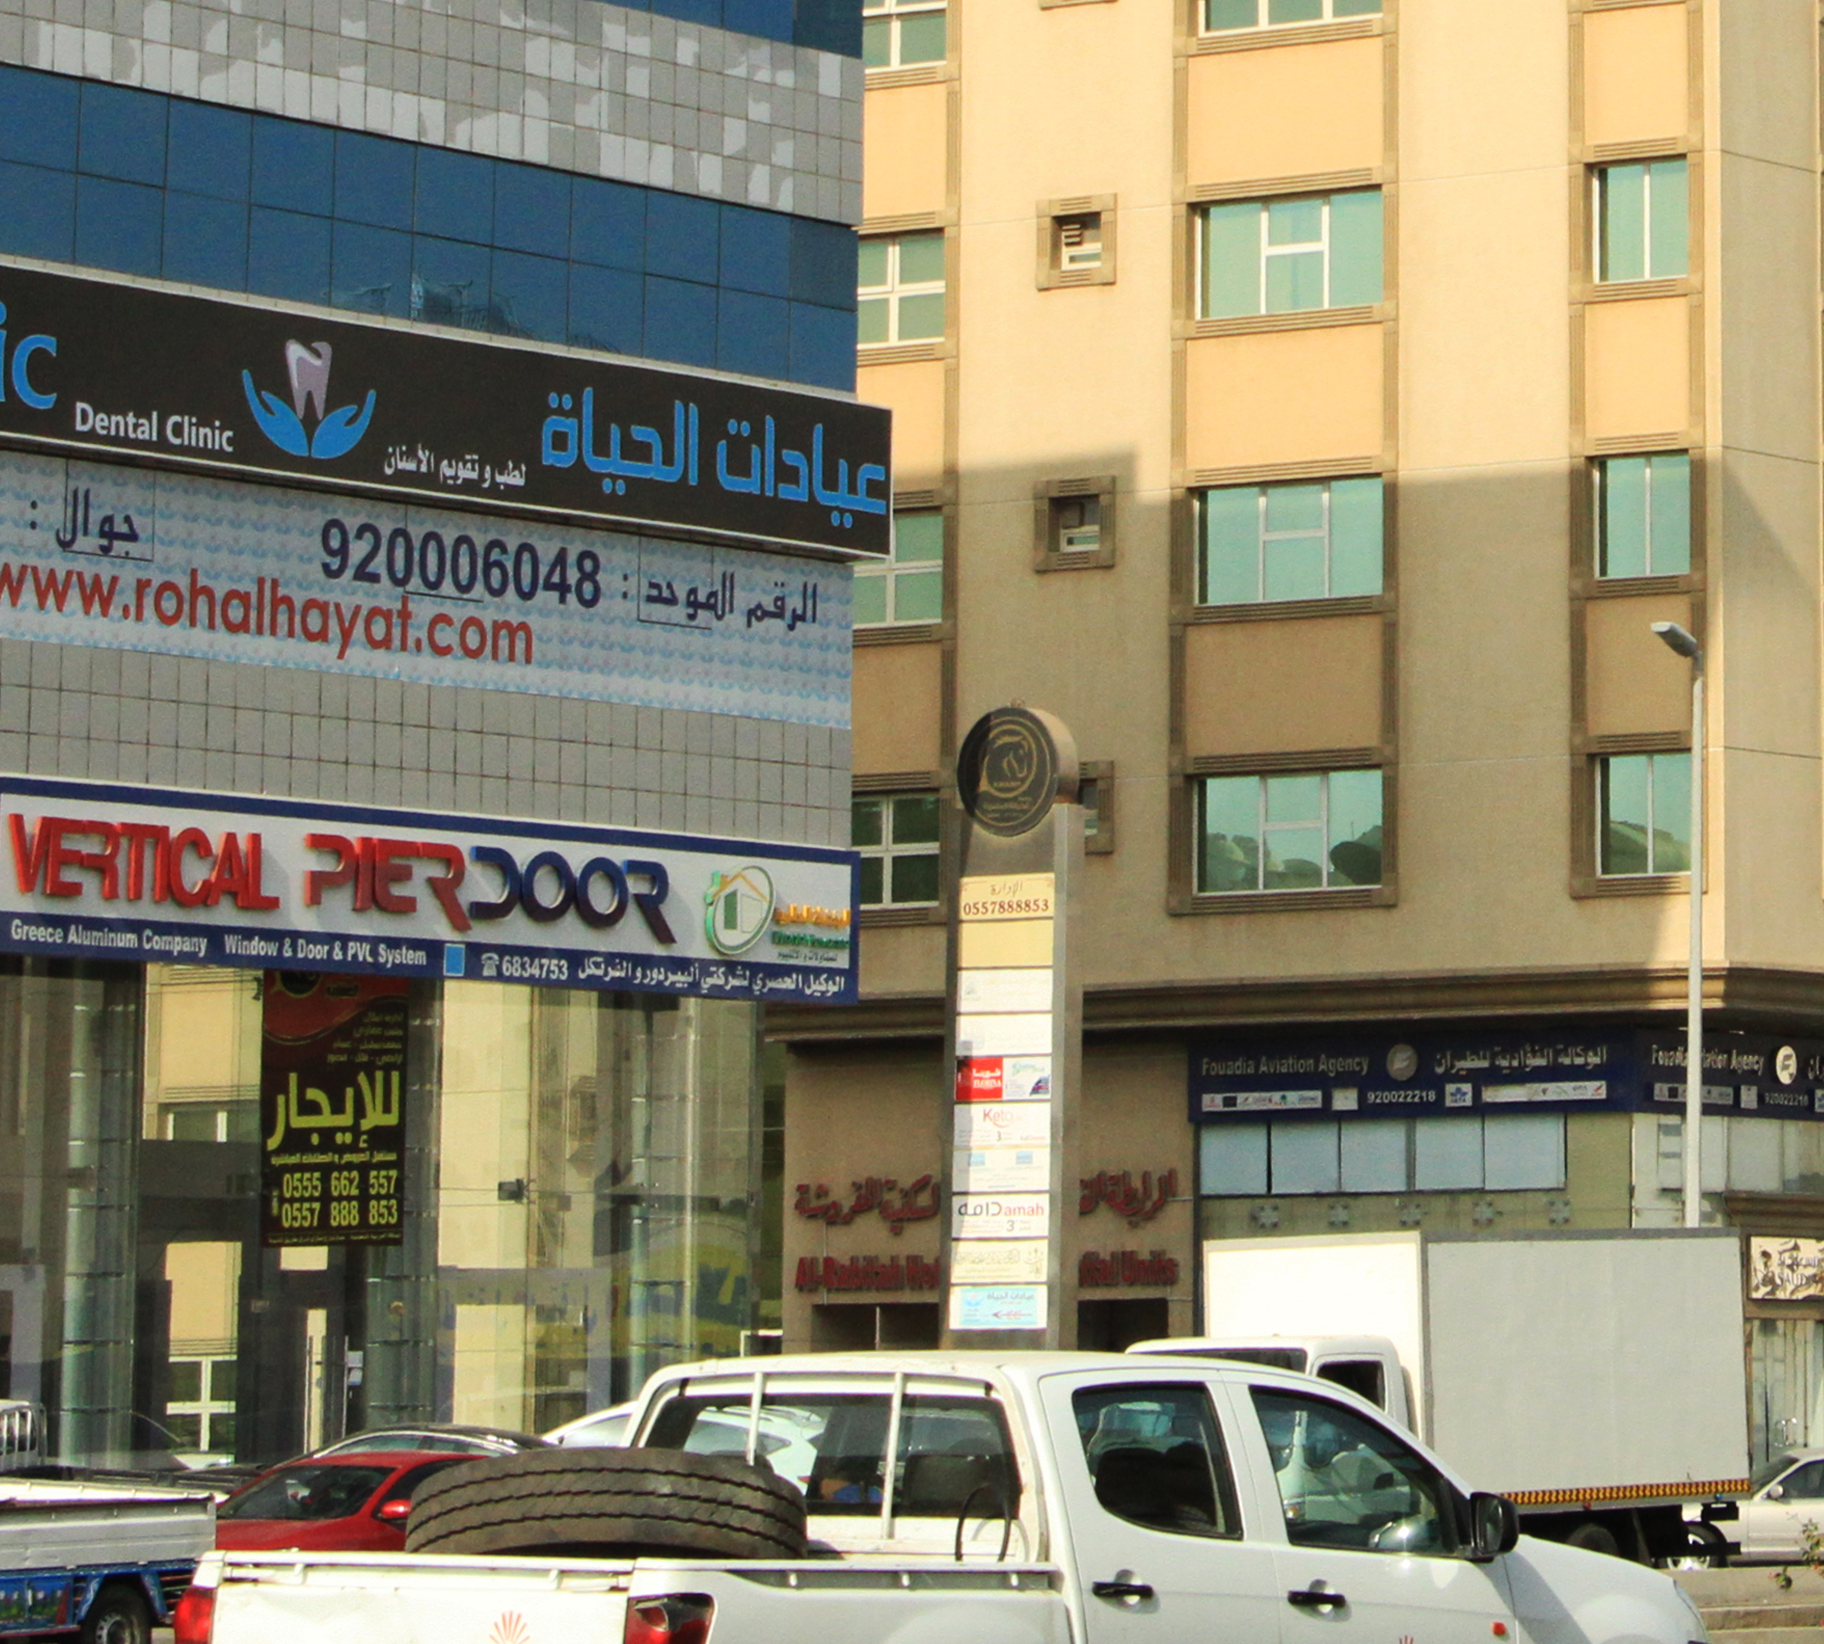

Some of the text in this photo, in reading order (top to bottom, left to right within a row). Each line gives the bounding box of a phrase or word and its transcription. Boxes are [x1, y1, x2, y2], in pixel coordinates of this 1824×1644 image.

[75, 401, 235, 453] Dental Clinic
[384, 442, 527, 490] لطب و تقويم الأسنان
[541, 387, 887, 529] عيادات الحياة
[56, 486, 140, 556] جوال
[321, 517, 602, 609] 920006048
[0, 562, 533, 665] www.rohalhayat.com
[645, 569, 735, 622] الموحد
[746, 581, 818, 632] الرقم
[8, 812, 281, 910] VERTICAL
[963, 898, 1049, 916] 0557888853
[11, 918, 65, 945] Greece
[67, 923, 139, 950] Aluminum
[142, 928, 208, 956] Company
[224, 932, 280, 957] Window
[282, 937, 294, 958] &
[297, 939, 330, 961] Door
[333, 940, 344, 962] &
[377, 943, 428, 969] System
[501, 955, 569, 981] 6834753
[701, 964, 750, 994] لشركتي
[752, 972, 803, 995] الحصري
[804, 972, 845, 997] الوكيل
[1201, 1054, 1370, 1077] Fouadia Aviation Agency
[266, 1069, 400, 1152] للإيجار
[1367, 1090, 1436, 1104] 920022218
[283, 1169, 398, 1198] 0555 662 557
[282, 1201, 321, 1228] 0557
[330, 1200, 360, 1227] 888
[369, 1198, 398, 1225] 853
